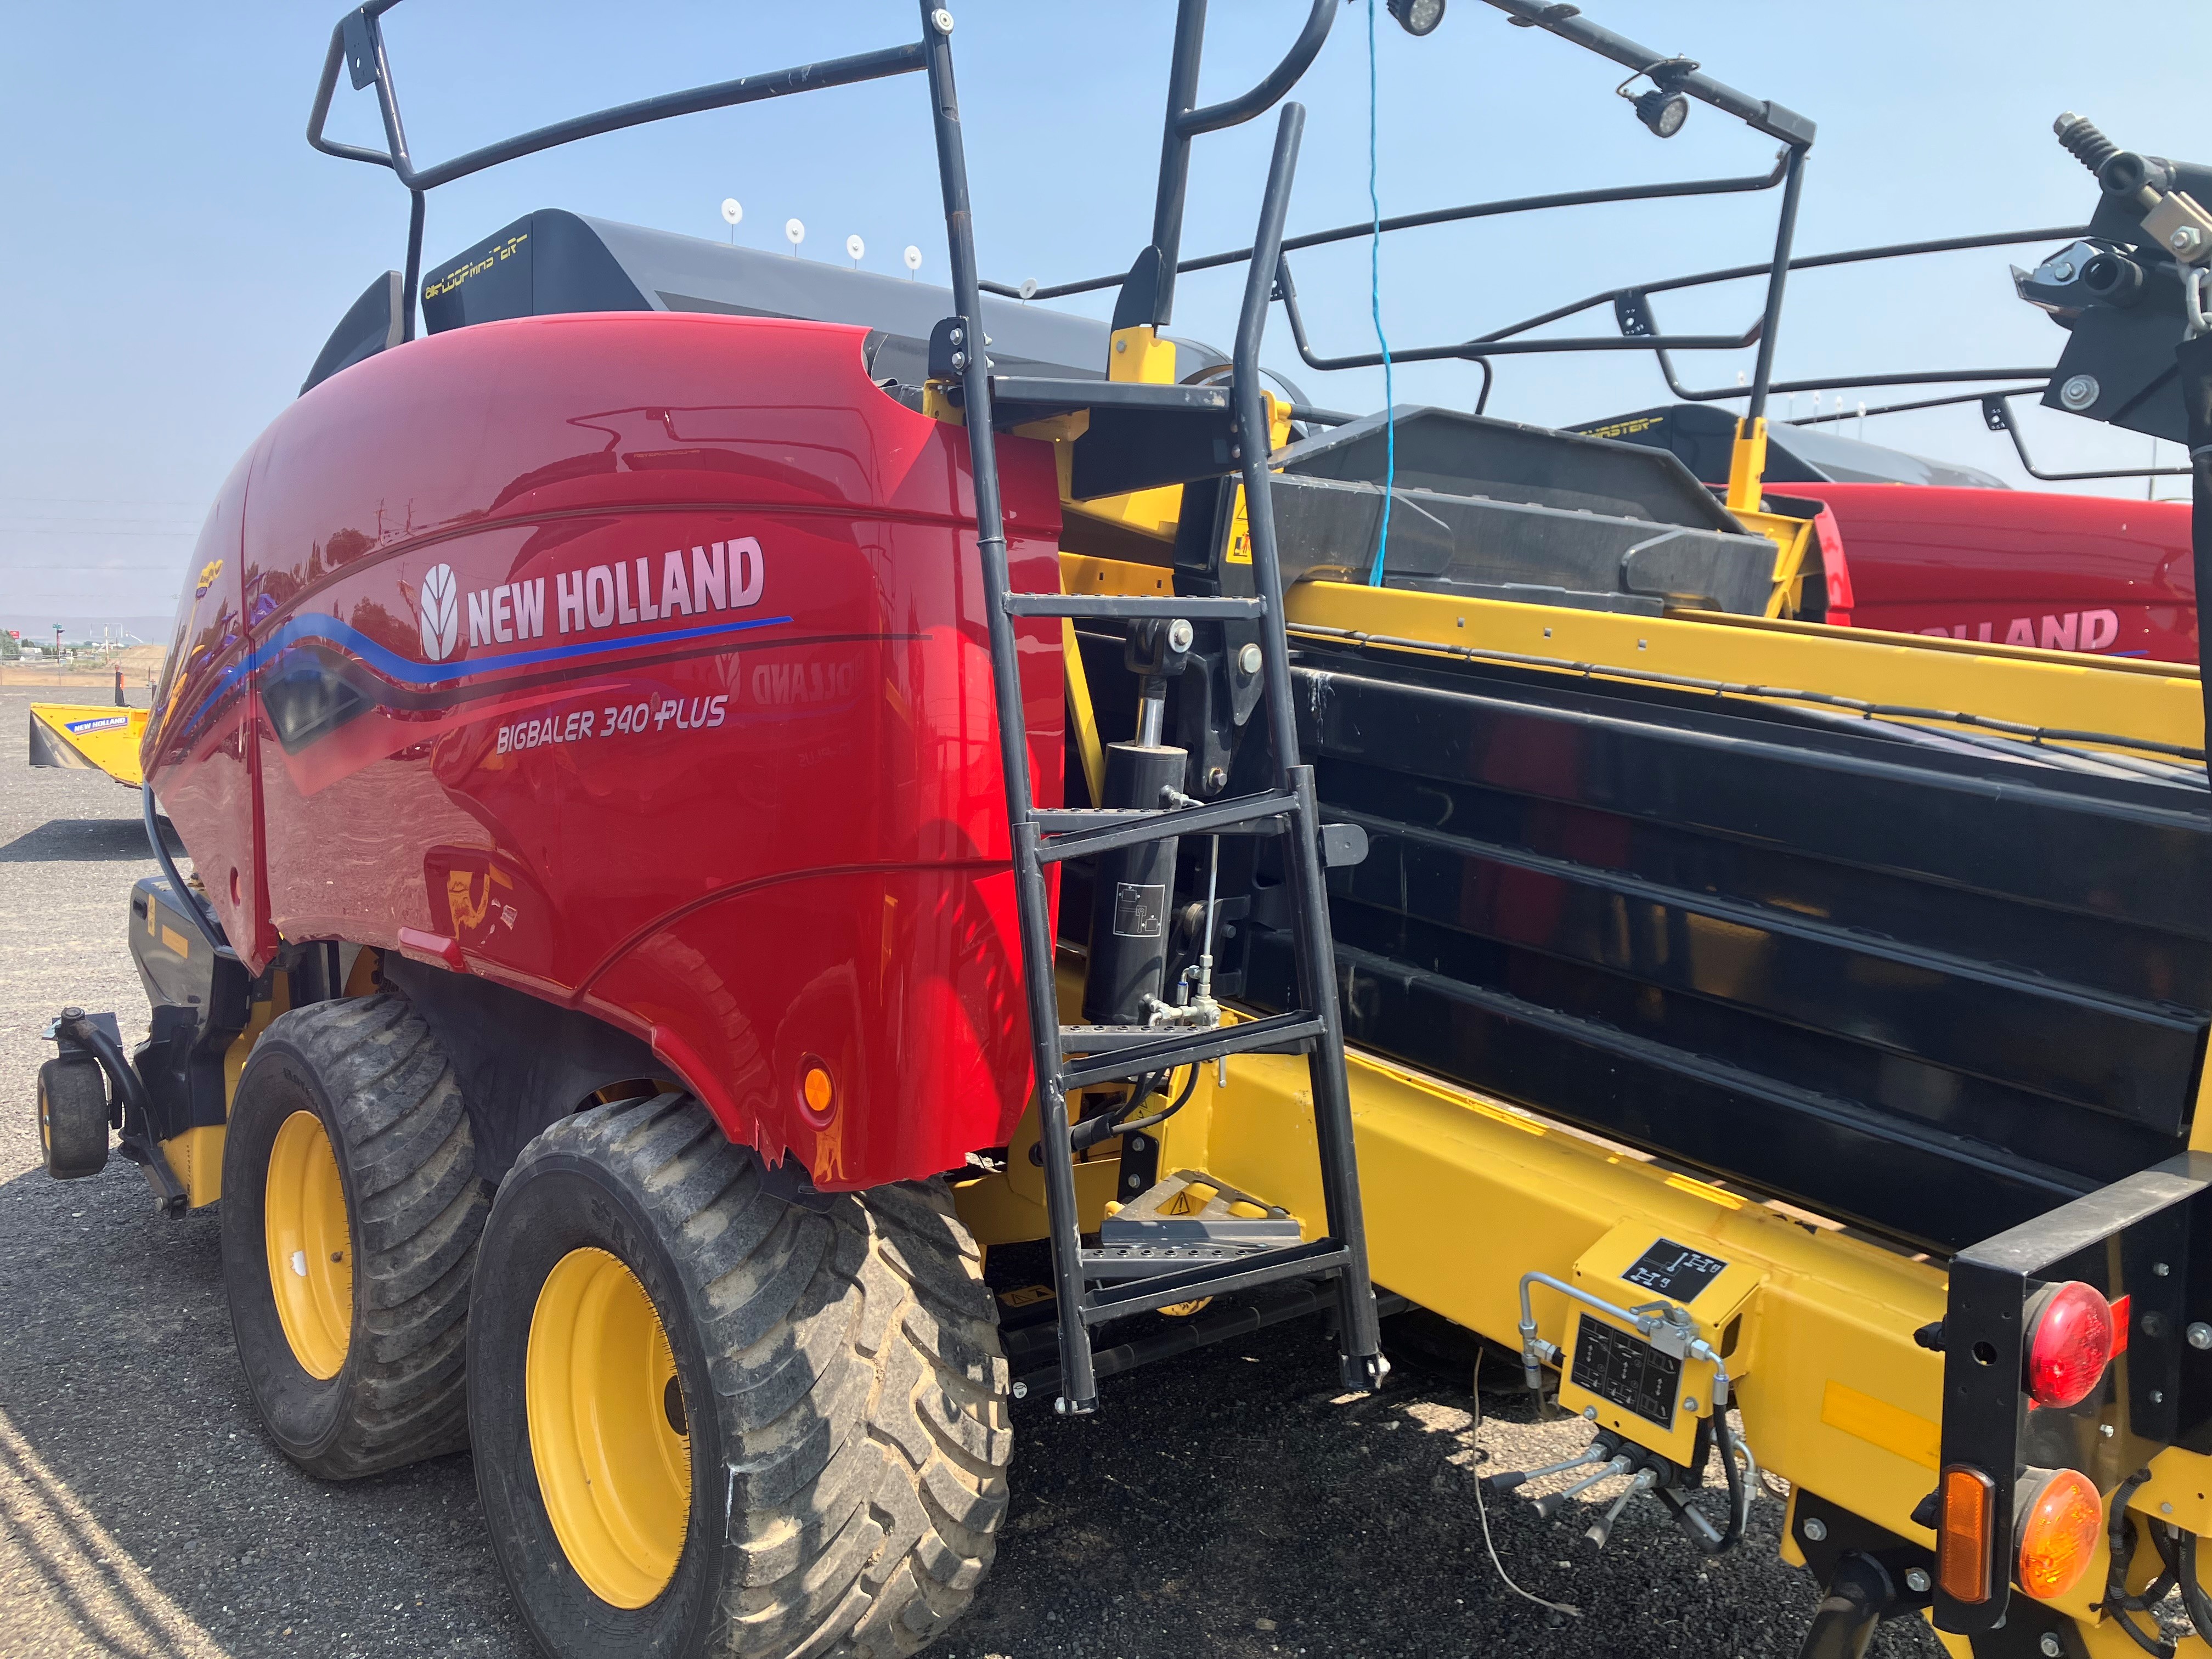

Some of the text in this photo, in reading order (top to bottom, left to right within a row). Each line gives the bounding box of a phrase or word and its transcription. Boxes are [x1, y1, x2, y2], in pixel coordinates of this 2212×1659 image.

[467, 536, 765, 647] NEW HOLLAND
[74, 723, 91, 732] NEW
[92, 717, 126, 728] HOLLAND
[496, 710, 595, 755] BIGBALER
[600, 703, 650, 737] 340
